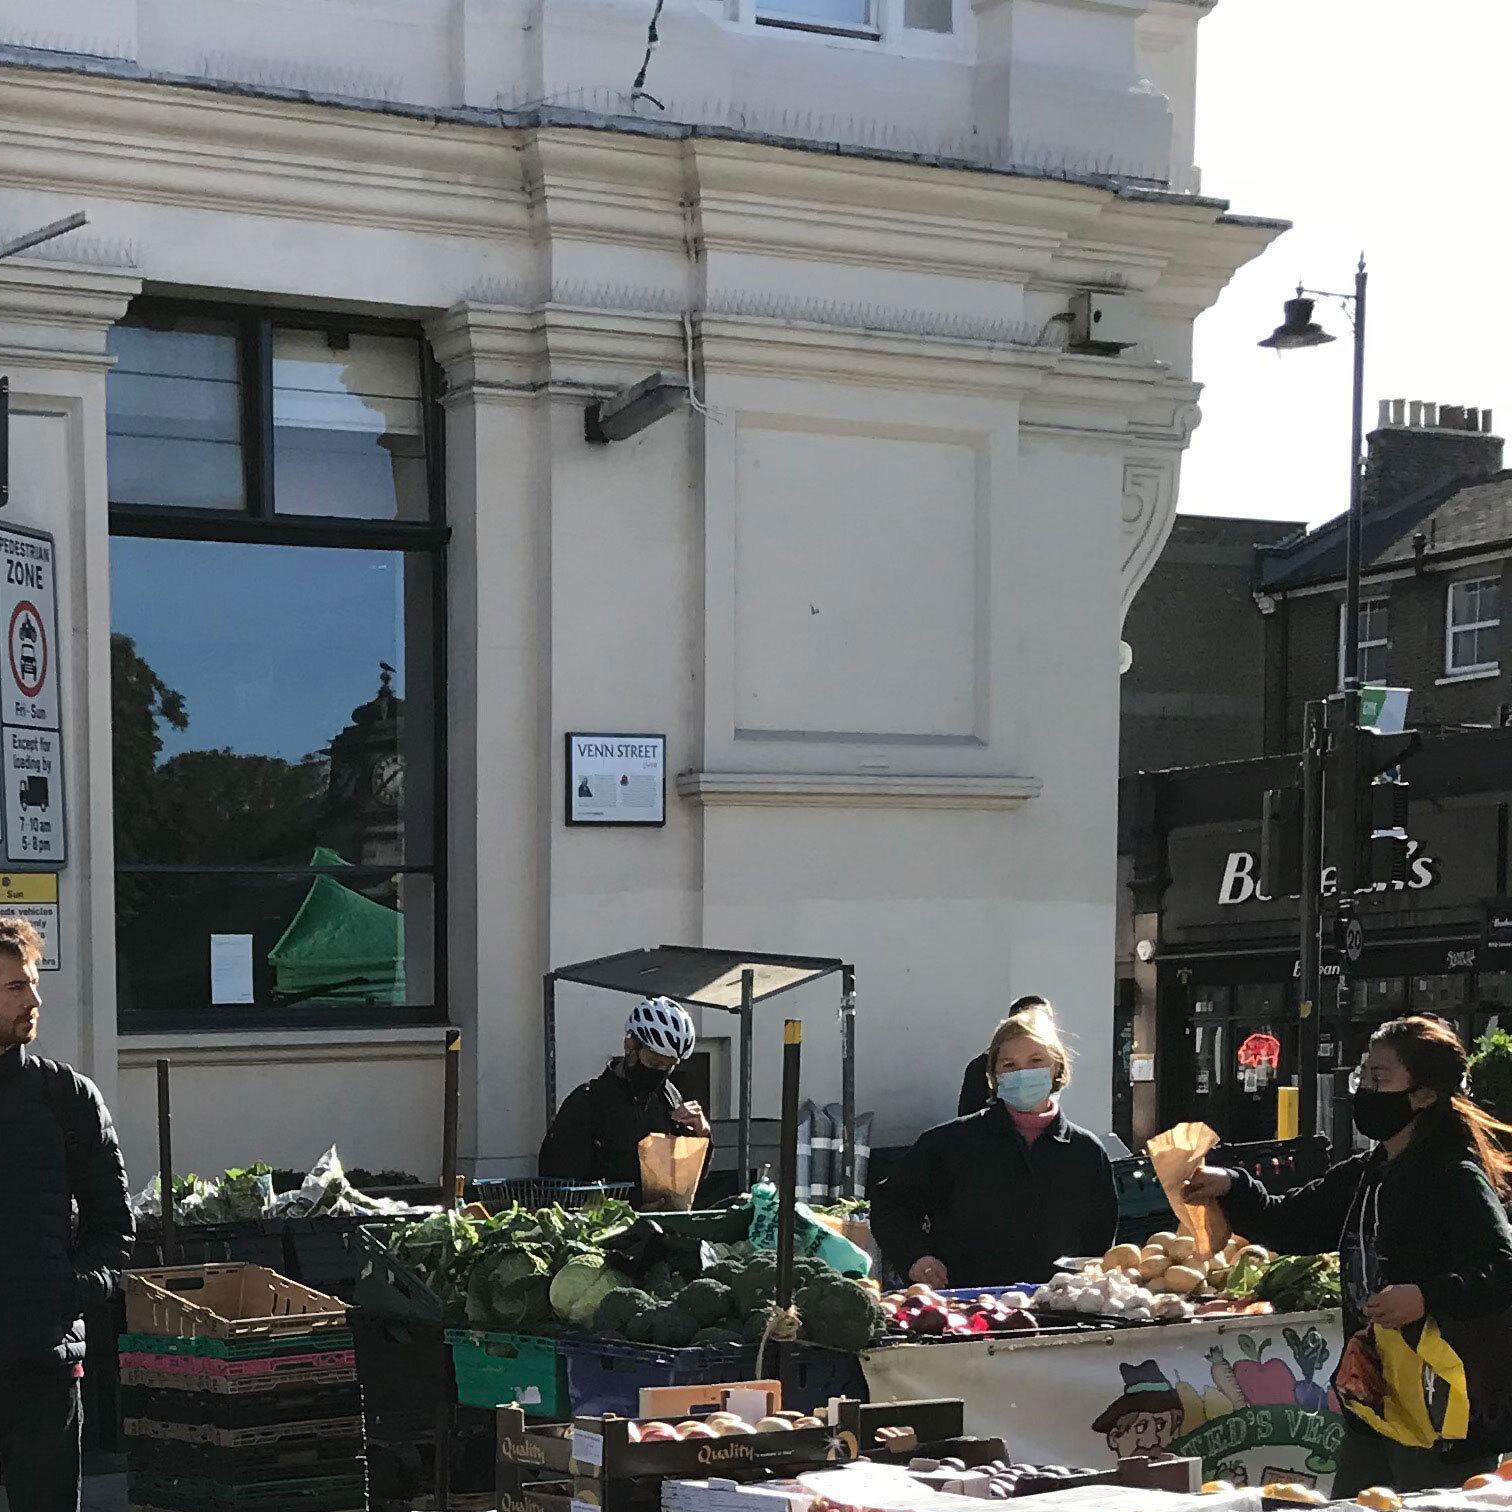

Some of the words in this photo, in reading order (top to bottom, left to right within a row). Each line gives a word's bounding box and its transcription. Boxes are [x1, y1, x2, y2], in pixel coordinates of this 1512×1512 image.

[7, 558, 44, 590] ZONE
[577, 743, 615, 758] VENN
[617, 744, 659, 759] STREET
[6, 890, 24, 899] Sun
[18, 907, 54, 916] vehicles
[1180, 1409, 1275, 1461] TED'S
[1284, 1407, 1347, 1453] VEG
[503, 1436, 546, 1464] Quality
[697, 1442, 754, 1465] Quality
